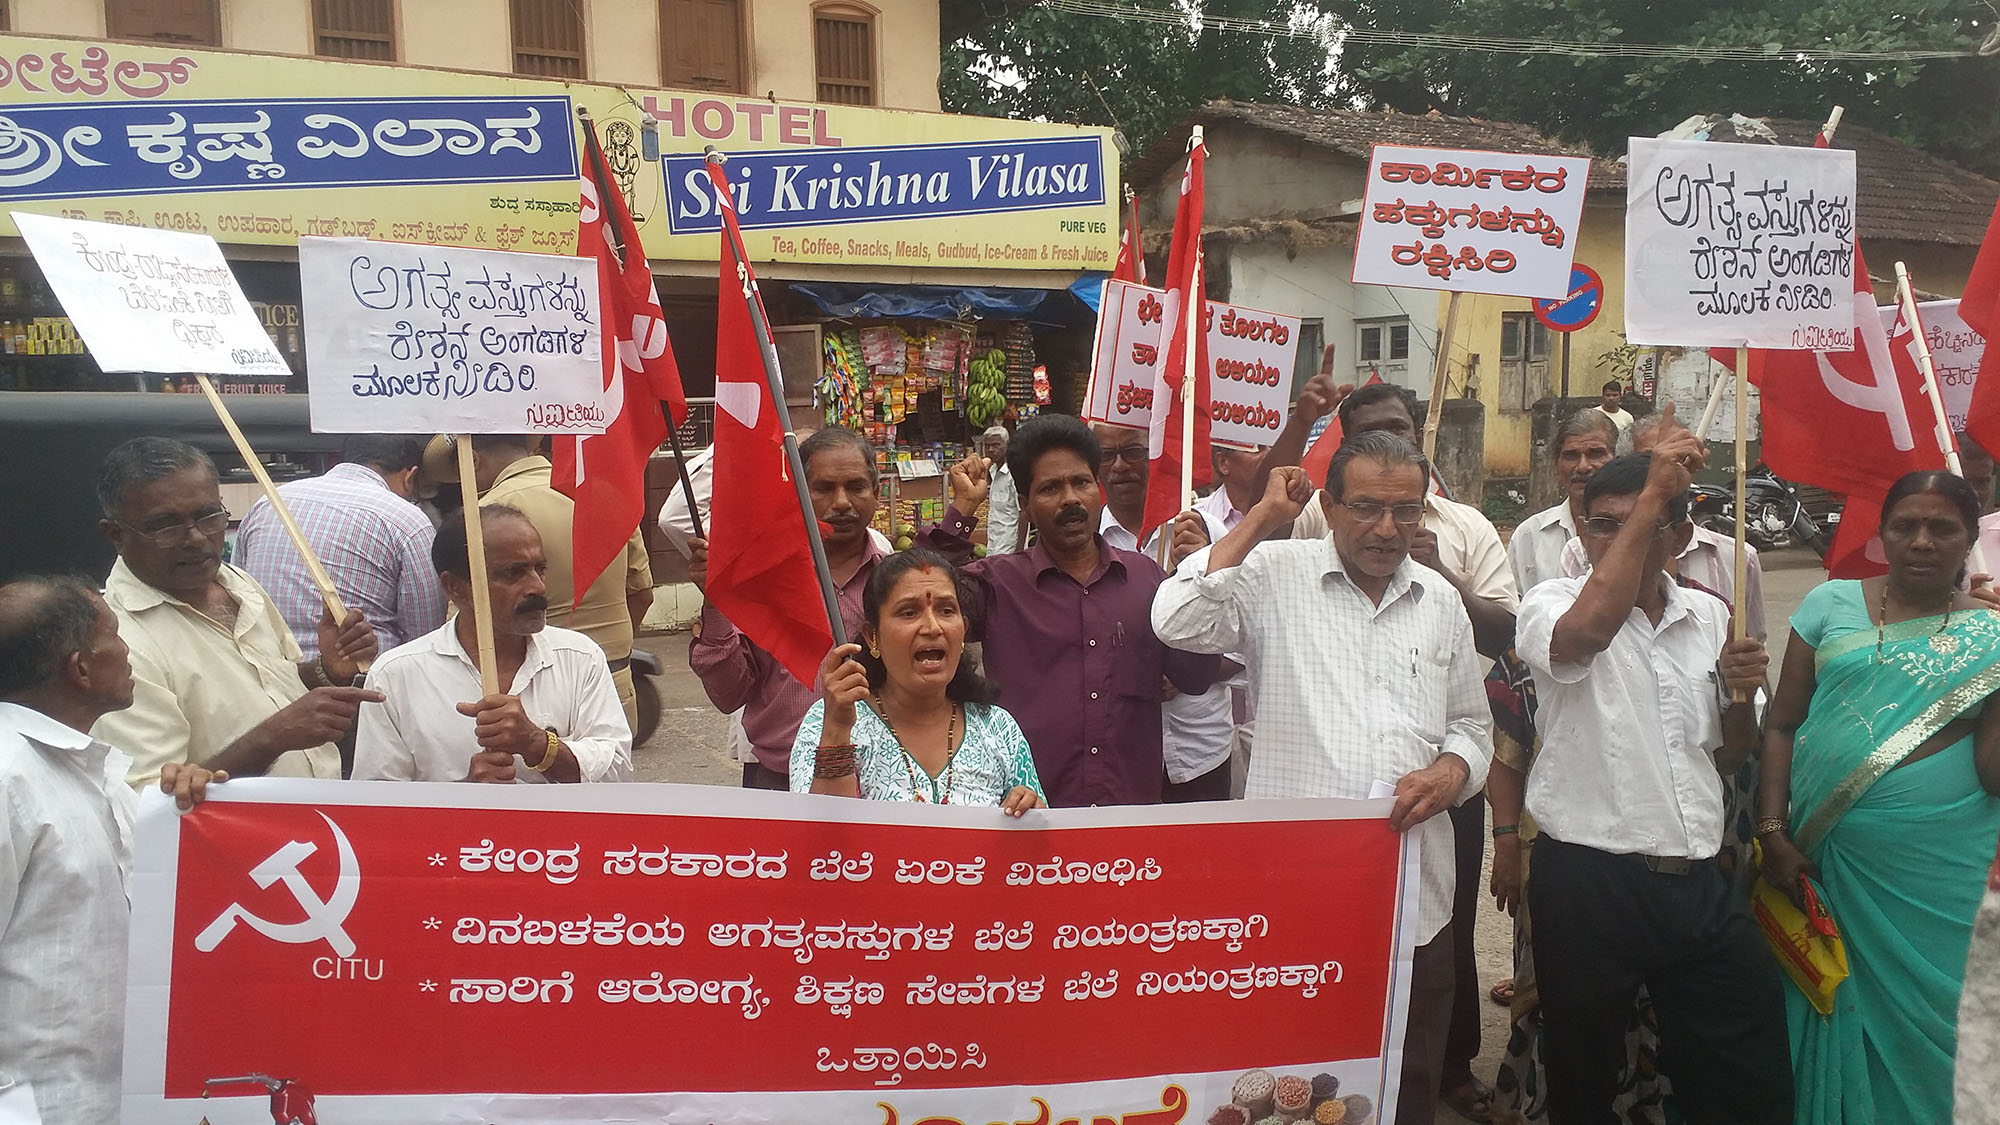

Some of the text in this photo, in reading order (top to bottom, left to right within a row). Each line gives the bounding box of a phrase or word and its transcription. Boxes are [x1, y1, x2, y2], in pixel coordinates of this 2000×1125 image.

[643, 96, 842, 147] HOTEL
[126, 111, 286, 179] ಕೃಷ್ಣ
[298, 107, 542, 157] ವಿಲಾಸ
[679, 151, 1090, 219] Sri Krishna Vilasa
[1380, 162, 1568, 193] ಕಾರ್ಮಿಕರ
[1372, 198, 1565, 249] ಹಕ್ಕುಗಳನ್ನು
[1656, 164, 1853, 244] ಅಗತ್ಯ ವಸ್ತುಗಳನ್ನು
[218, 213, 299, 237] ಉಪಹಾರ,
[475, 225, 488, 242] &
[1060, 222, 1107, 233] PURE VEG
[773, 236, 1109, 262] Tea, Coffee, Snacks, Meals, Gudbud, Ice-Cream & Fresh Juice
[1391, 240, 1517, 281] ರಕ್ಷಿಸಿರಿ
[350, 256, 595, 325] ಅಗತ್ಯ ವಸ್ತುಗಳನ್ನು
[1547, 303, 1557, 311] NO
[254, 304, 299, 328] ICE
[1220, 308, 1289, 346] ತೊಲಗಲಿ
[480, 325, 587, 355] ಅಂಗಡಿಗಳ
[224, 384, 255, 395] FRUIT
[1215, 358, 1280, 387] ಅಳಿಯಲಿ
[458, 838, 1163, 887] ಕೇಂದ್ರ ಸರಕಾರದ ಬೆಲೆ ಏರಿಕೆ ವಿರೋಧಿಸಿ
[451, 912, 1269, 964] ದಿನಬಳಕೆಯ ಅಗತ್ಯವಸ್ತುಗಳ ಬೆಲೆ ನಿಯಂತ್ರಣಕ್ಕಾಗಿ
[312, 957, 384, 982] CITU
[449, 960, 1343, 1020] ಸಾರಿಗೆ ಆರೋಗ್ಯ, ಶಿಕ್ಷಣ ಸೇವೆಗಳ ಬೆಲೆ ನಿಯಂತ್ರಣಕ್ಕಾಗಿ
[816, 1042, 987, 1086] ಒತ್ತಾಯಿಸಿ
